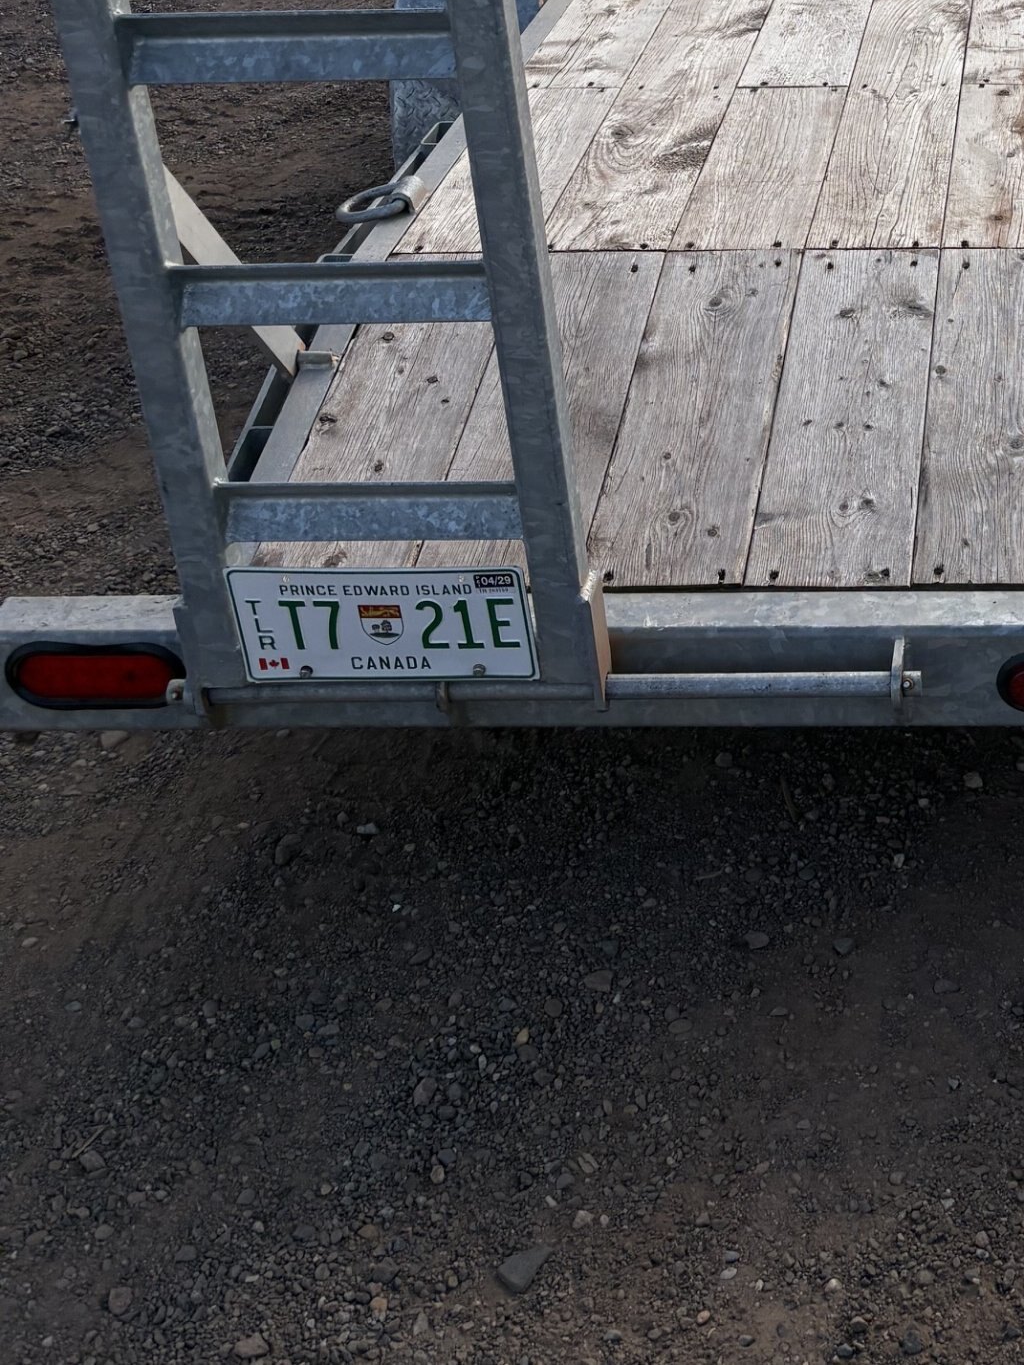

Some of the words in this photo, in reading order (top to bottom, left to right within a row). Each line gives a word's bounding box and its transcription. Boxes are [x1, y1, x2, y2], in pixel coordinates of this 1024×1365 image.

[480, 575, 511, 586] 04/29
[279, 584, 338, 597] PRINCE
[343, 584, 410, 596] EDWARD
[416, 583, 472, 596] ISLAND
[278, 600, 340, 650] T7
[415, 598, 521, 650] 21E
[351, 656, 432, 670] CANADA
